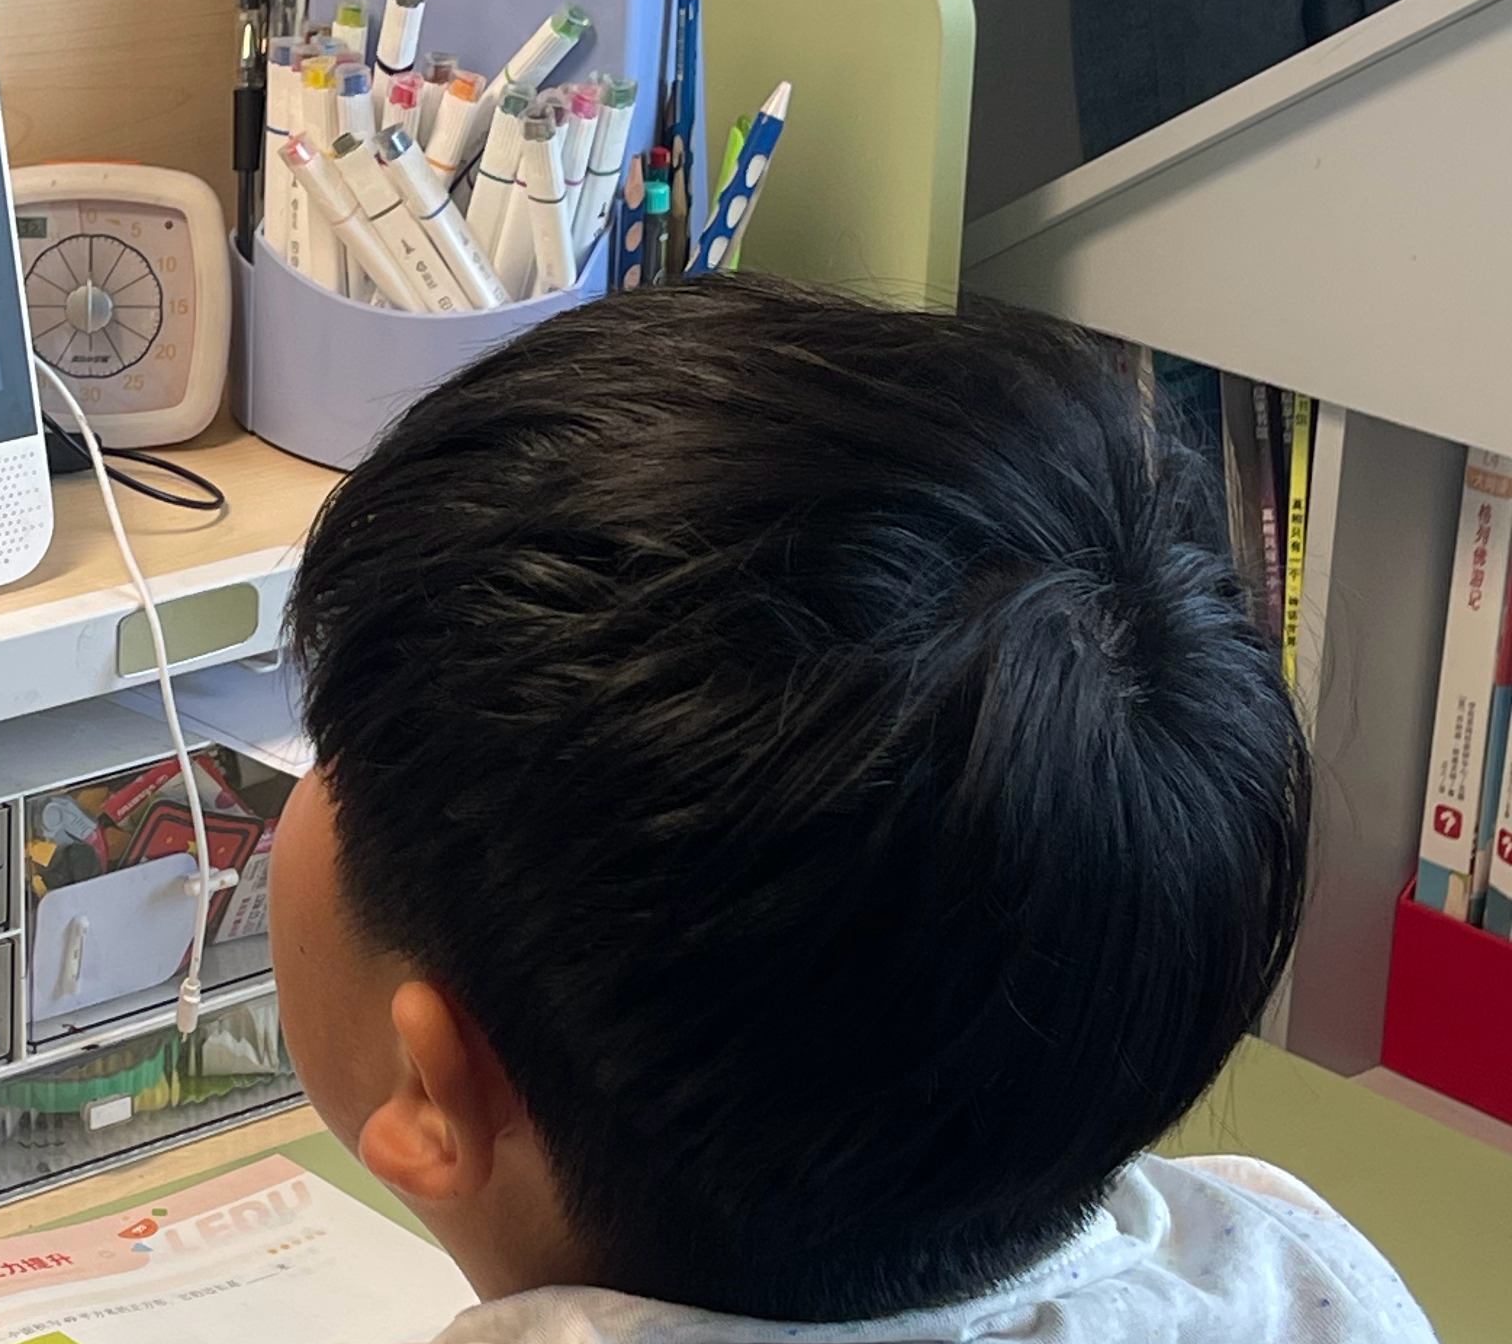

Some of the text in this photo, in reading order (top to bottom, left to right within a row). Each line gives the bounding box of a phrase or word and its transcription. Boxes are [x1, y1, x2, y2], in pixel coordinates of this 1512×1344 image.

[157, 257, 177, 273] 10
[156, 344, 177, 360] 20
[123, 374, 144, 391] 25
